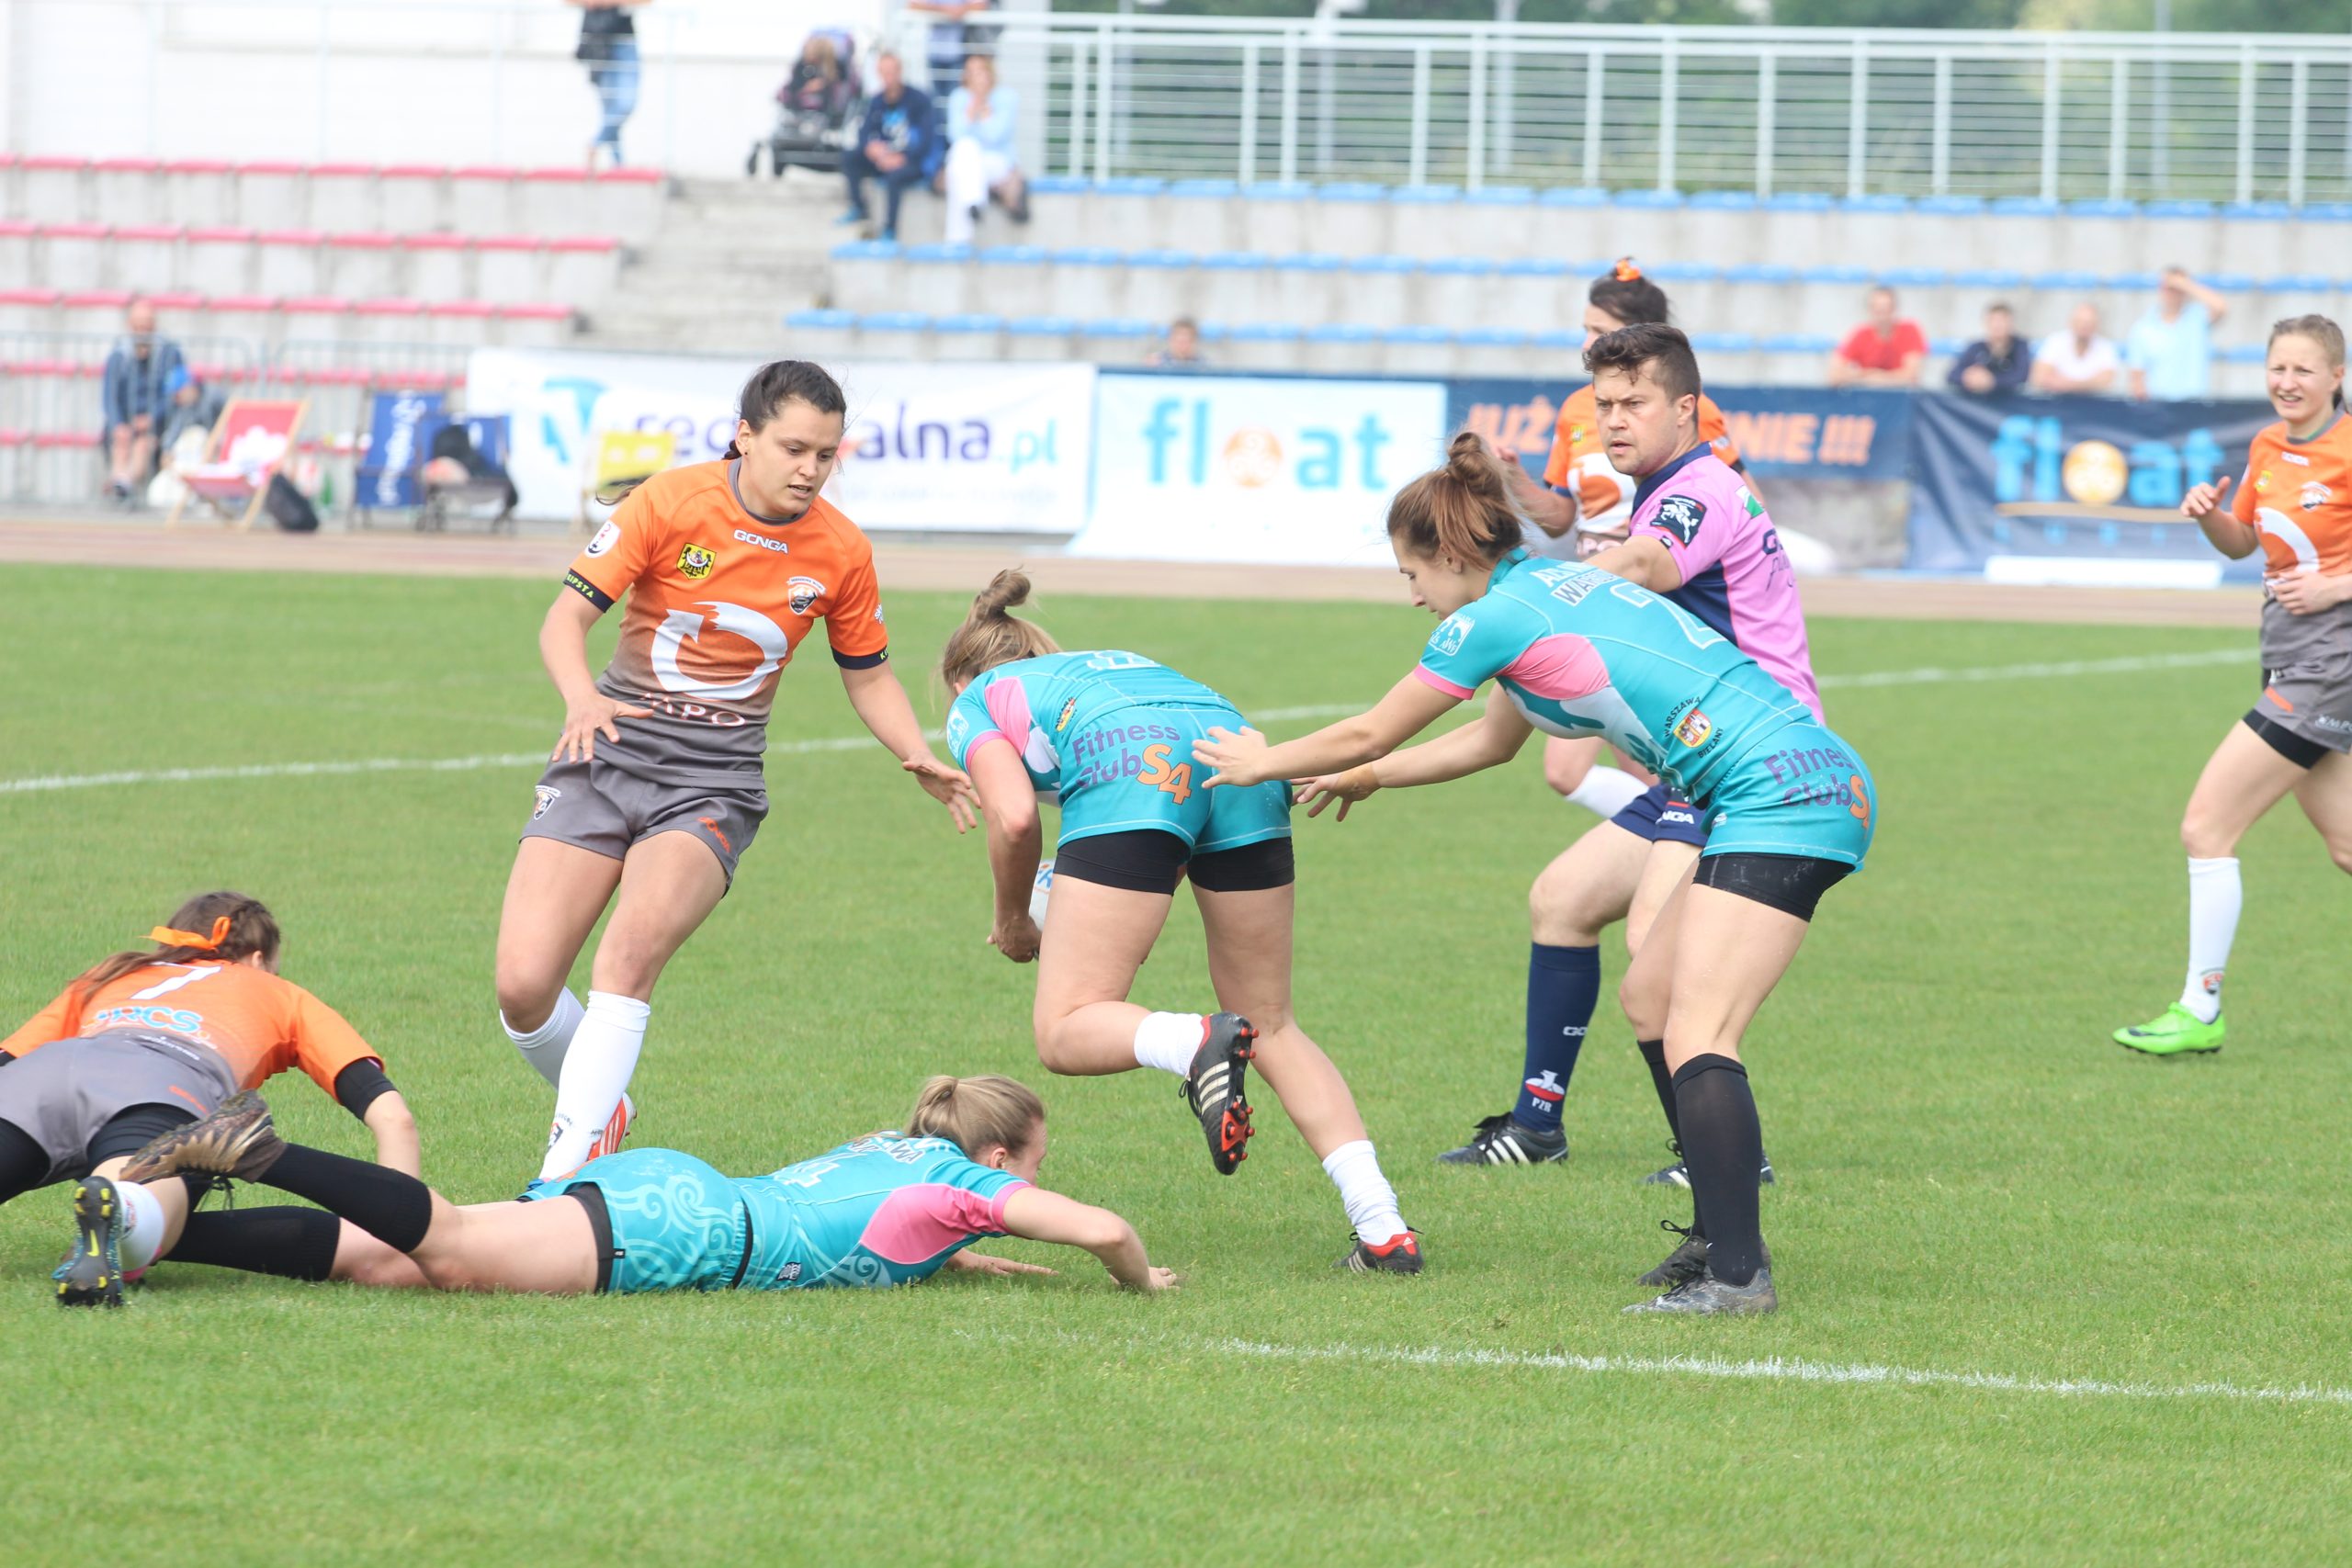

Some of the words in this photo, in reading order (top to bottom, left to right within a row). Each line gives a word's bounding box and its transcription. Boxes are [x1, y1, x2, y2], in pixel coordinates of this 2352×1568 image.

[1142, 397, 1393, 490] float
[1664, 696, 1701, 737] WARSZAWA
[1072, 724, 1181, 765] Fitness
[1697, 728, 1724, 759] BIELANY
[1076, 750, 1142, 789] club
[1136, 744, 1193, 805] S4
[1782, 773, 1852, 807] club
[130, 962, 221, 999] 7
[1532, 1097, 1552, 1114] PZR
